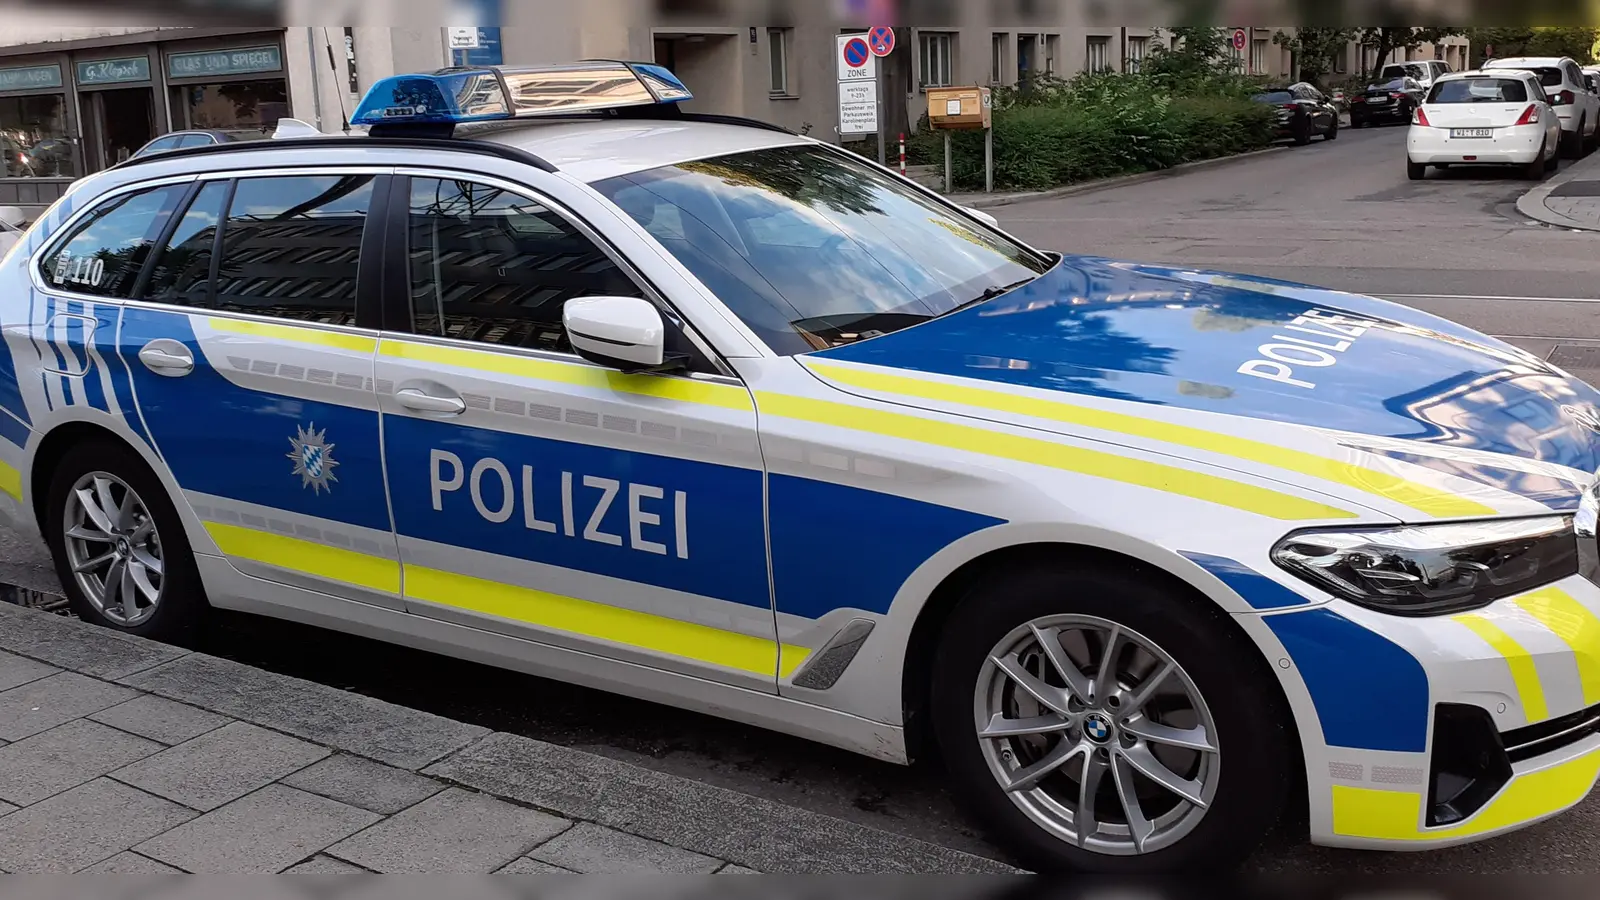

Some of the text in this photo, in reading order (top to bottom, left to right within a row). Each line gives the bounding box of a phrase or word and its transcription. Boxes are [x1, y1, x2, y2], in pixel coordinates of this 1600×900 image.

[847, 69, 867, 78] ZONE
[71, 256, 104, 287] 110
[430, 448, 689, 560] POLIZEI
